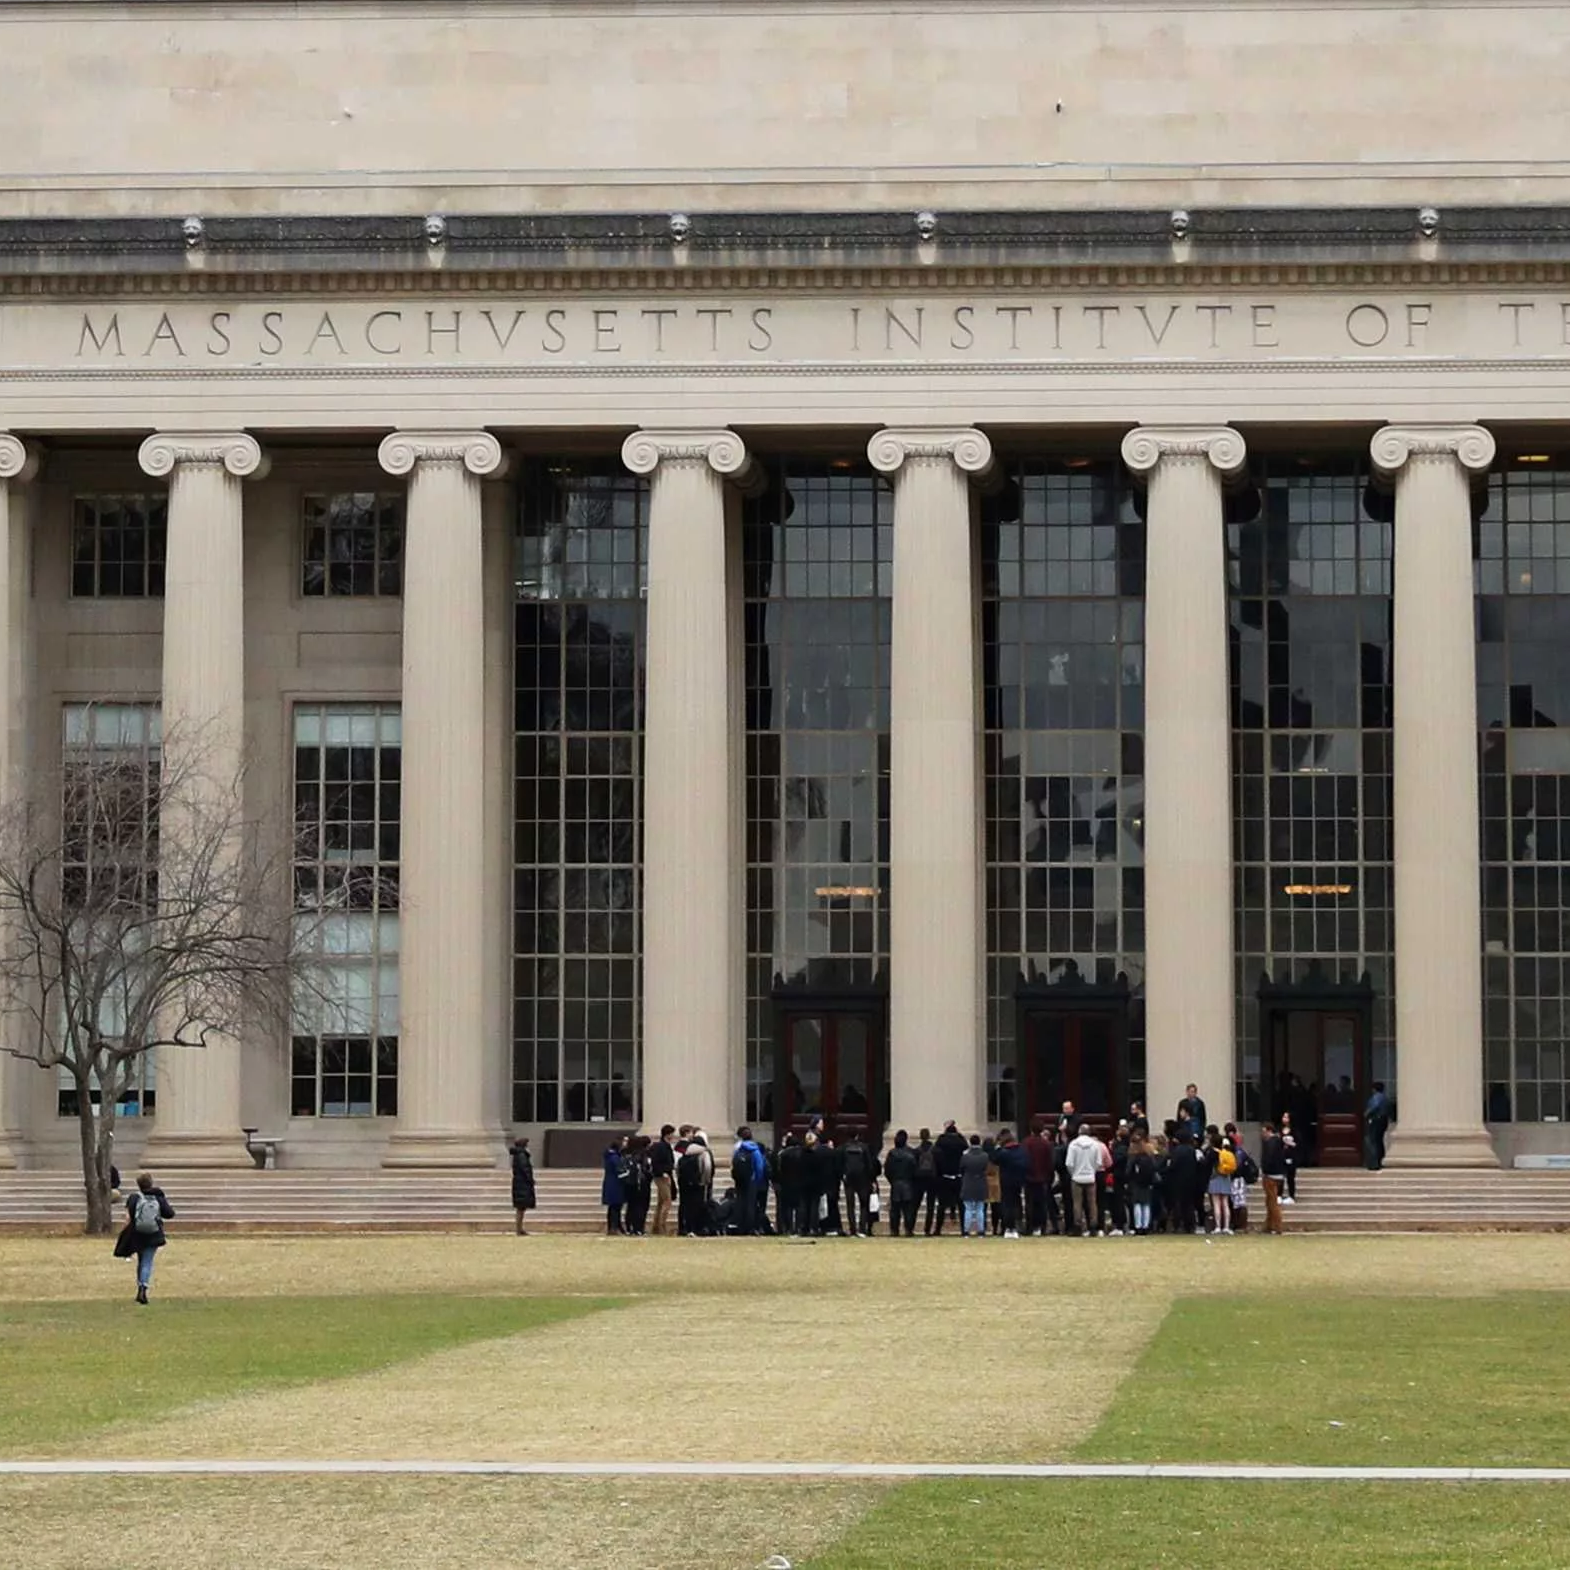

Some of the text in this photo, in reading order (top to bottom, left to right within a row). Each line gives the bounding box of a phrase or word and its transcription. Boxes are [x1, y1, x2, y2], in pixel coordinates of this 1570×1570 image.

[75, 307, 773, 357] MASSACHVSETTS
[850, 304, 1280, 352] INSTITVTE
[1345, 302, 1433, 348] OF
